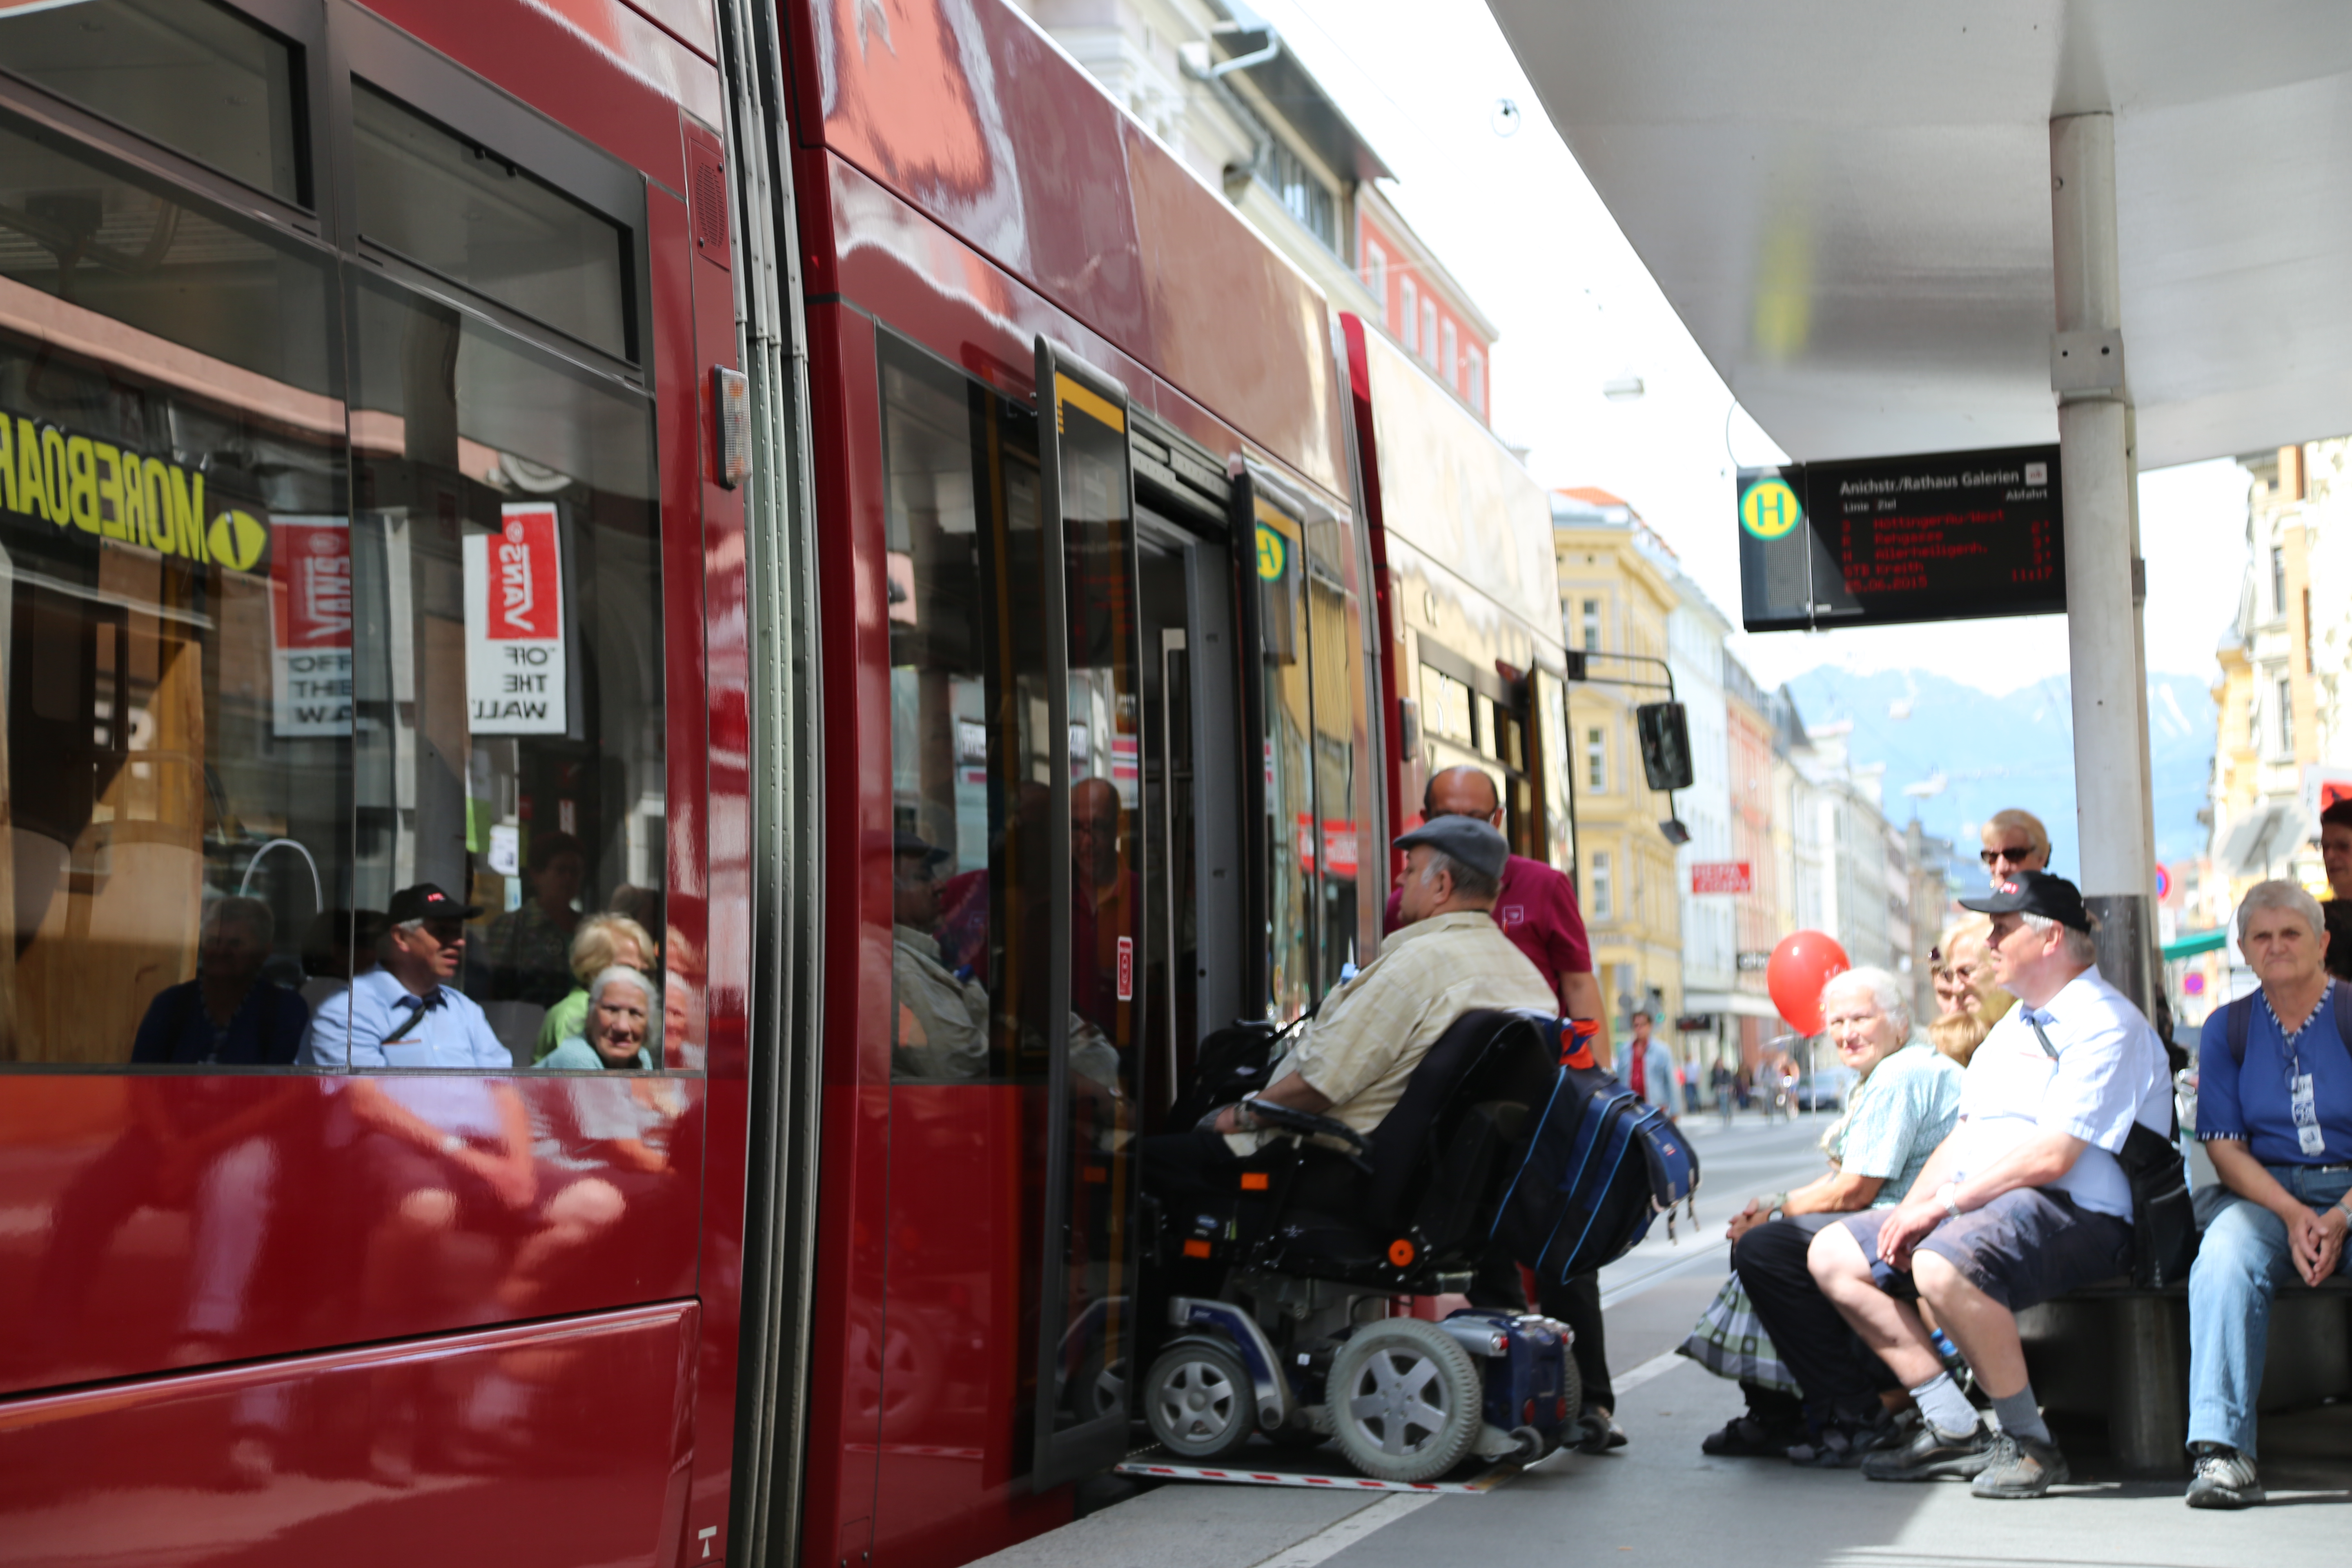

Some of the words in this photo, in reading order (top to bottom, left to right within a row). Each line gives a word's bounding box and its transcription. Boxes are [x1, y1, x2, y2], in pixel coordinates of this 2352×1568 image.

[1840, 474, 1958, 497] Anichstr./Rathaus
[1962, 470, 2019, 488] Galerien
[2006, 488, 2047, 501] Abfahrt
[1757, 490, 1785, 526] H
[1843, 501, 1869, 513] Linie
[1877, 498, 1897, 511] Ziel
